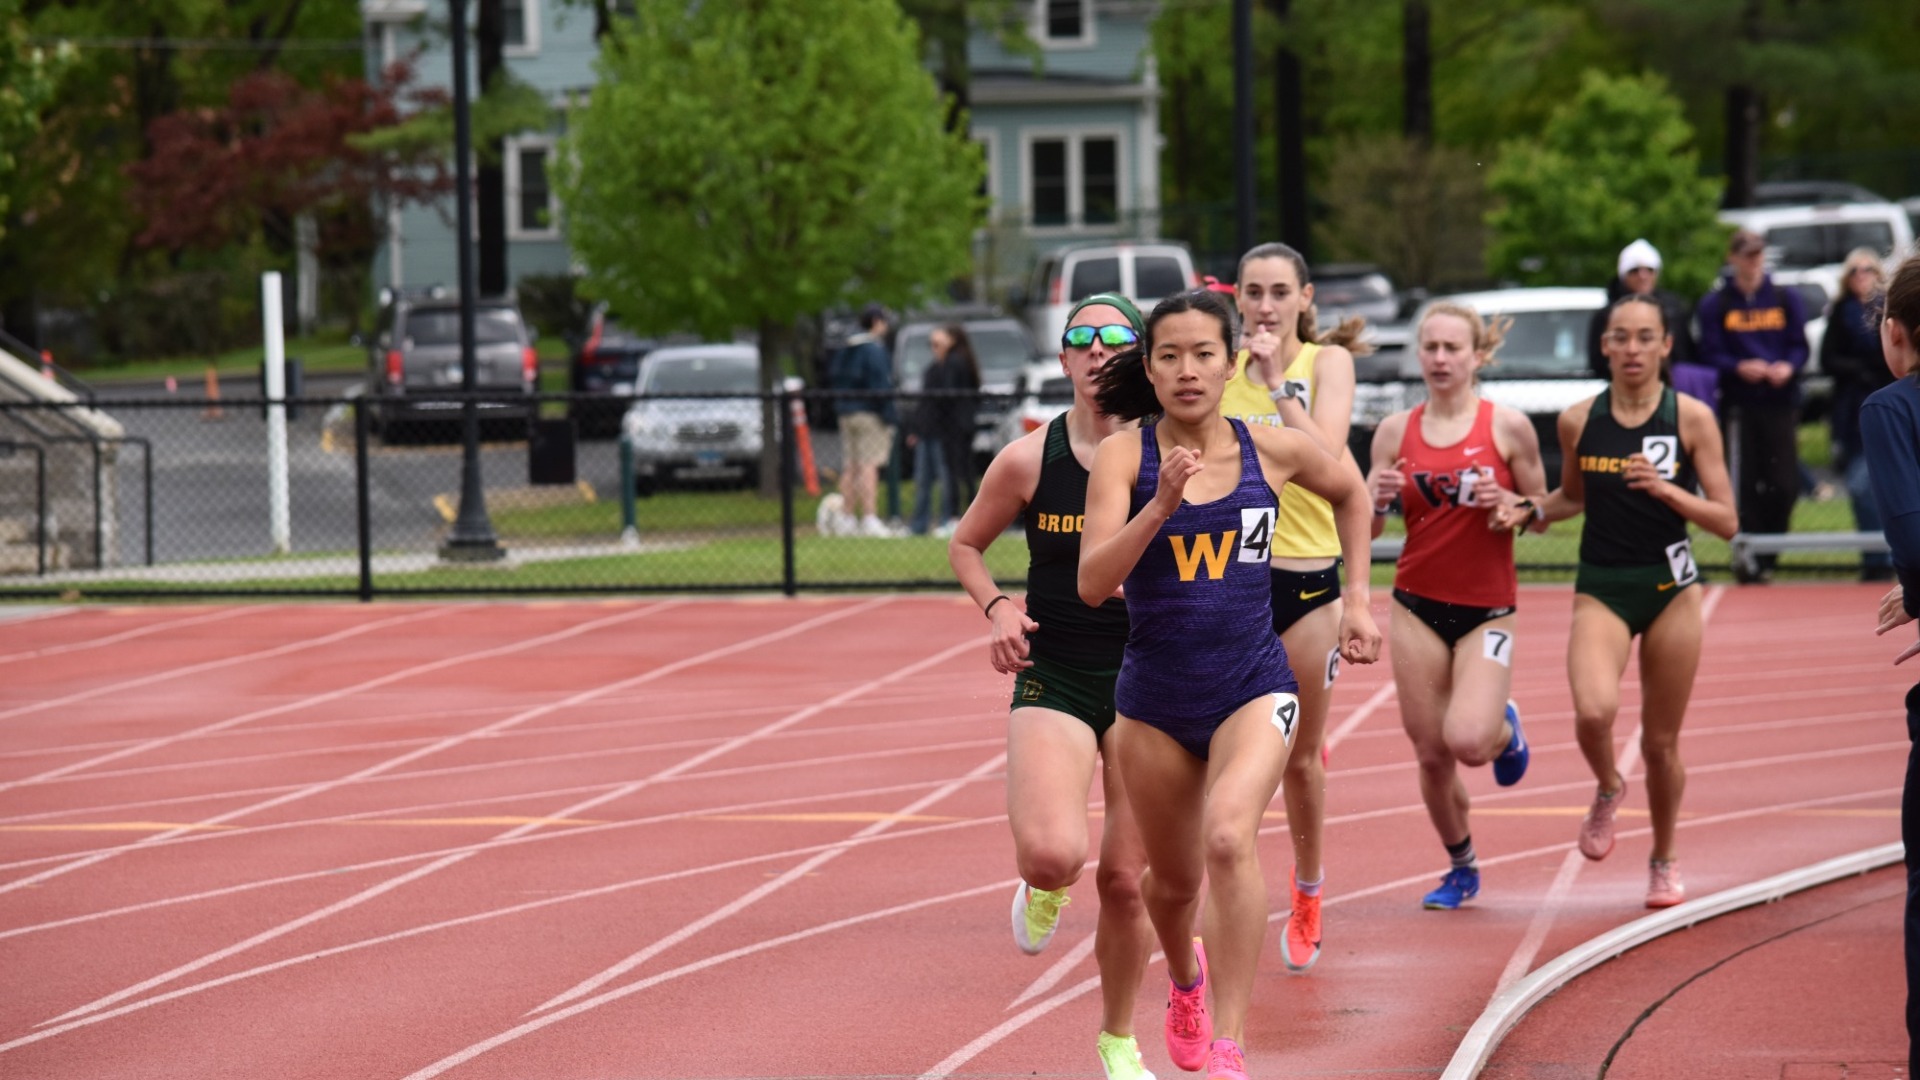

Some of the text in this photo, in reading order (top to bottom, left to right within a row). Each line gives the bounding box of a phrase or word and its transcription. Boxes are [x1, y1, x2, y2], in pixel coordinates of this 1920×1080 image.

[1649, 441, 1669, 474] 2
[1243, 511, 1269, 560] 4
[1168, 530, 1238, 582] W
[1673, 545, 1694, 582] 2
[1488, 630, 1509, 657] 7
[1276, 699, 1297, 738] 4
